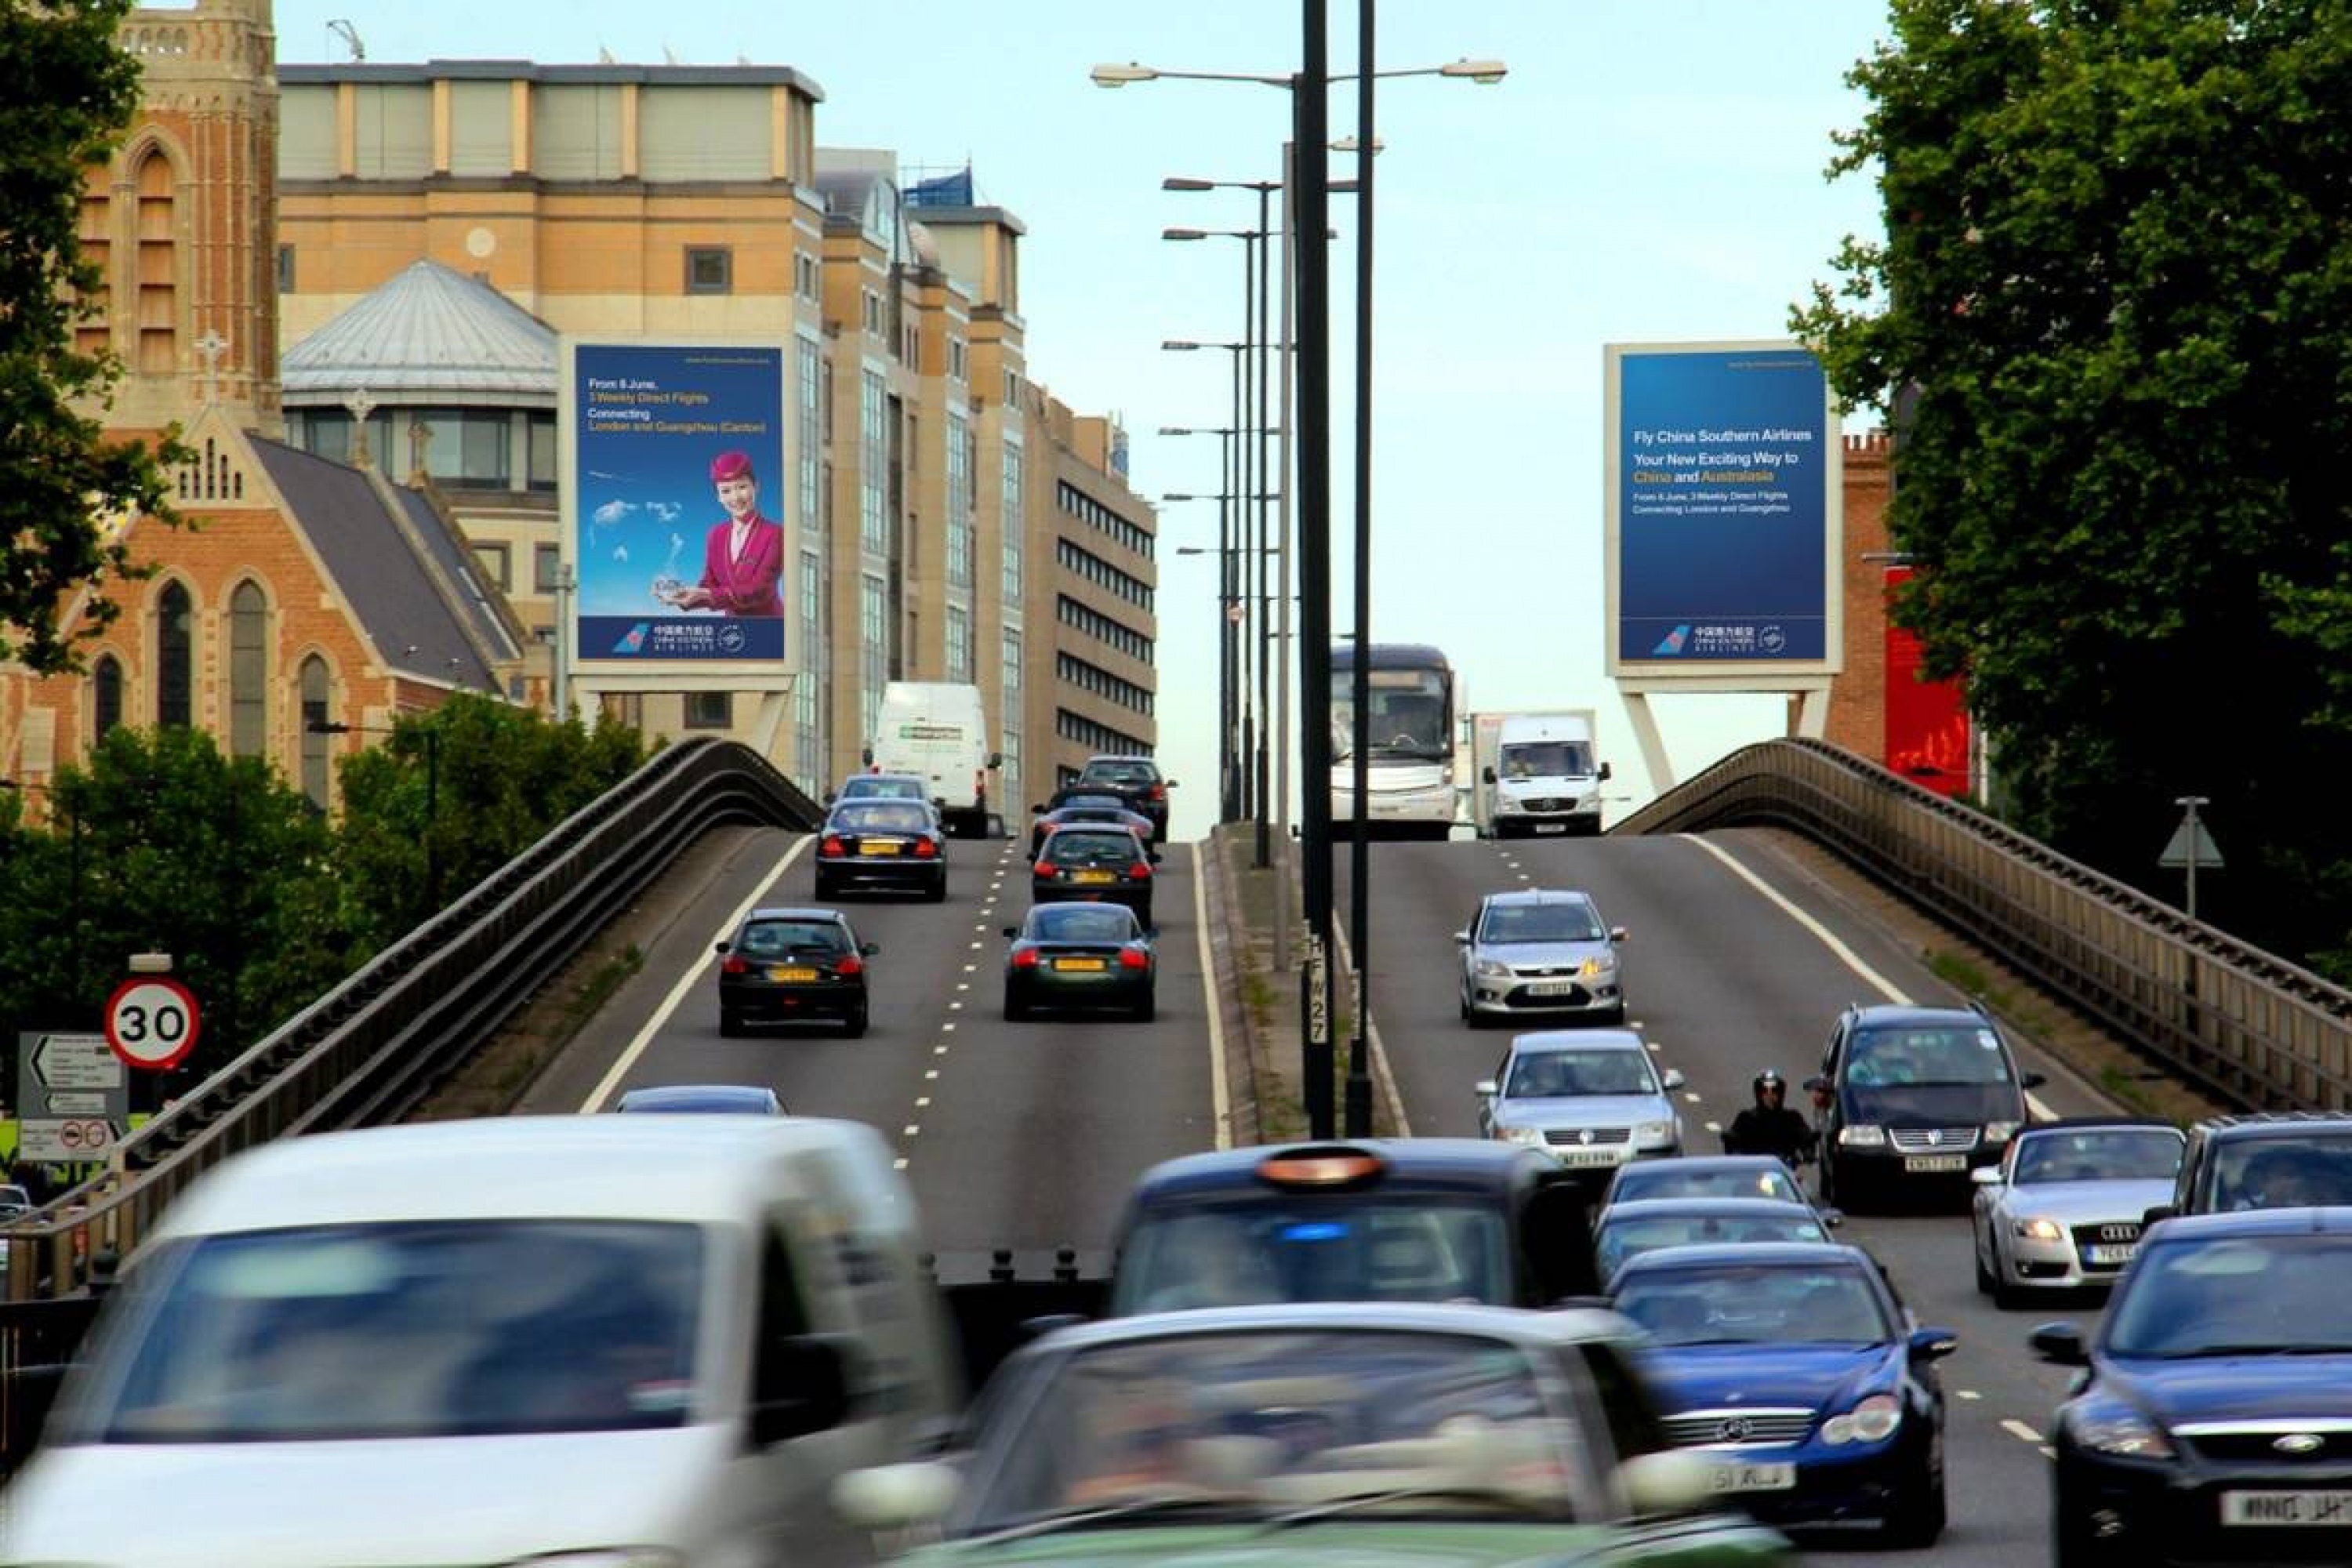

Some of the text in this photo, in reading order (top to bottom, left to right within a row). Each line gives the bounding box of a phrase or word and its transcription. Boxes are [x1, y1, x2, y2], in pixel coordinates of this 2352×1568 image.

[590, 378, 617, 389] From
[588, 408, 651, 422] Connecting
[589, 419, 630, 431] London
[1634, 428, 1813, 447] Fly China Southern Airlines
[1633, 452, 1800, 467] Your New Exciting Way to
[1633, 471, 1672, 484] China
[1674, 470, 1700, 483] and
[1632, 504, 1683, 516] Connecting
[121, 1005, 185, 1042] 30
